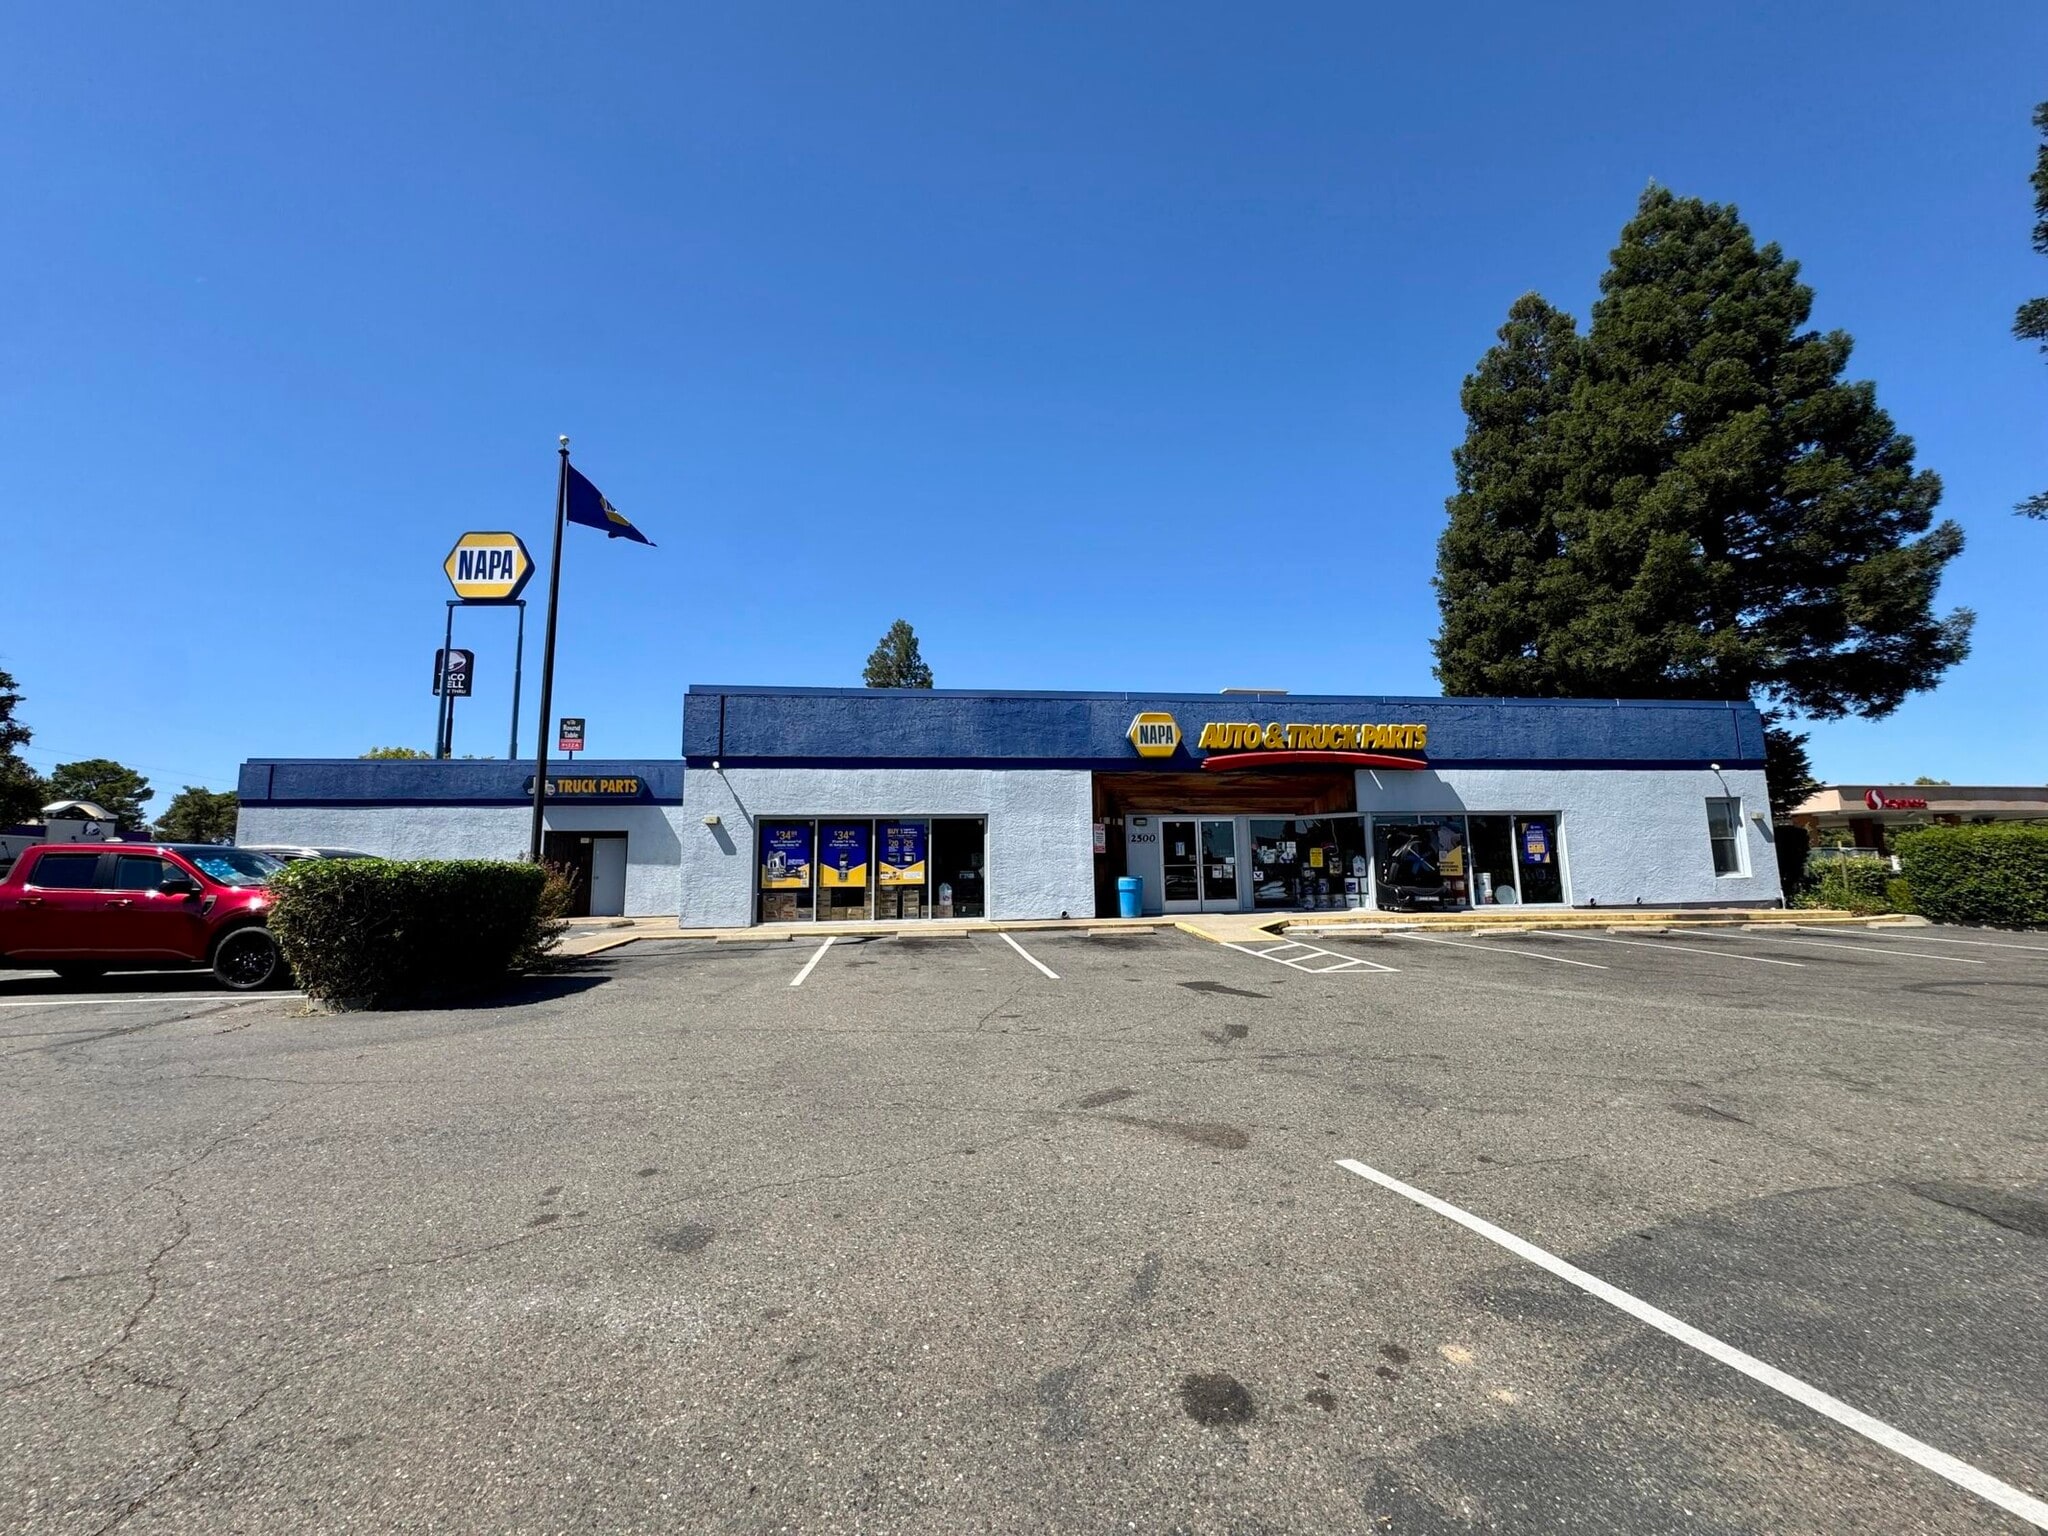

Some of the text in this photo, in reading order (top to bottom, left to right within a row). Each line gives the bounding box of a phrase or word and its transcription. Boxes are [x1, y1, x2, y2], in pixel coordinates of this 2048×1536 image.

[458, 550, 513, 580] NAPA
[1140, 725, 1173, 744] NAPA
[1198, 722, 1428, 750] AUTO & TRUCK PARTS
[557, 779, 638, 793] TRUCK PARTS
[1130, 834, 1156, 843] 2500
